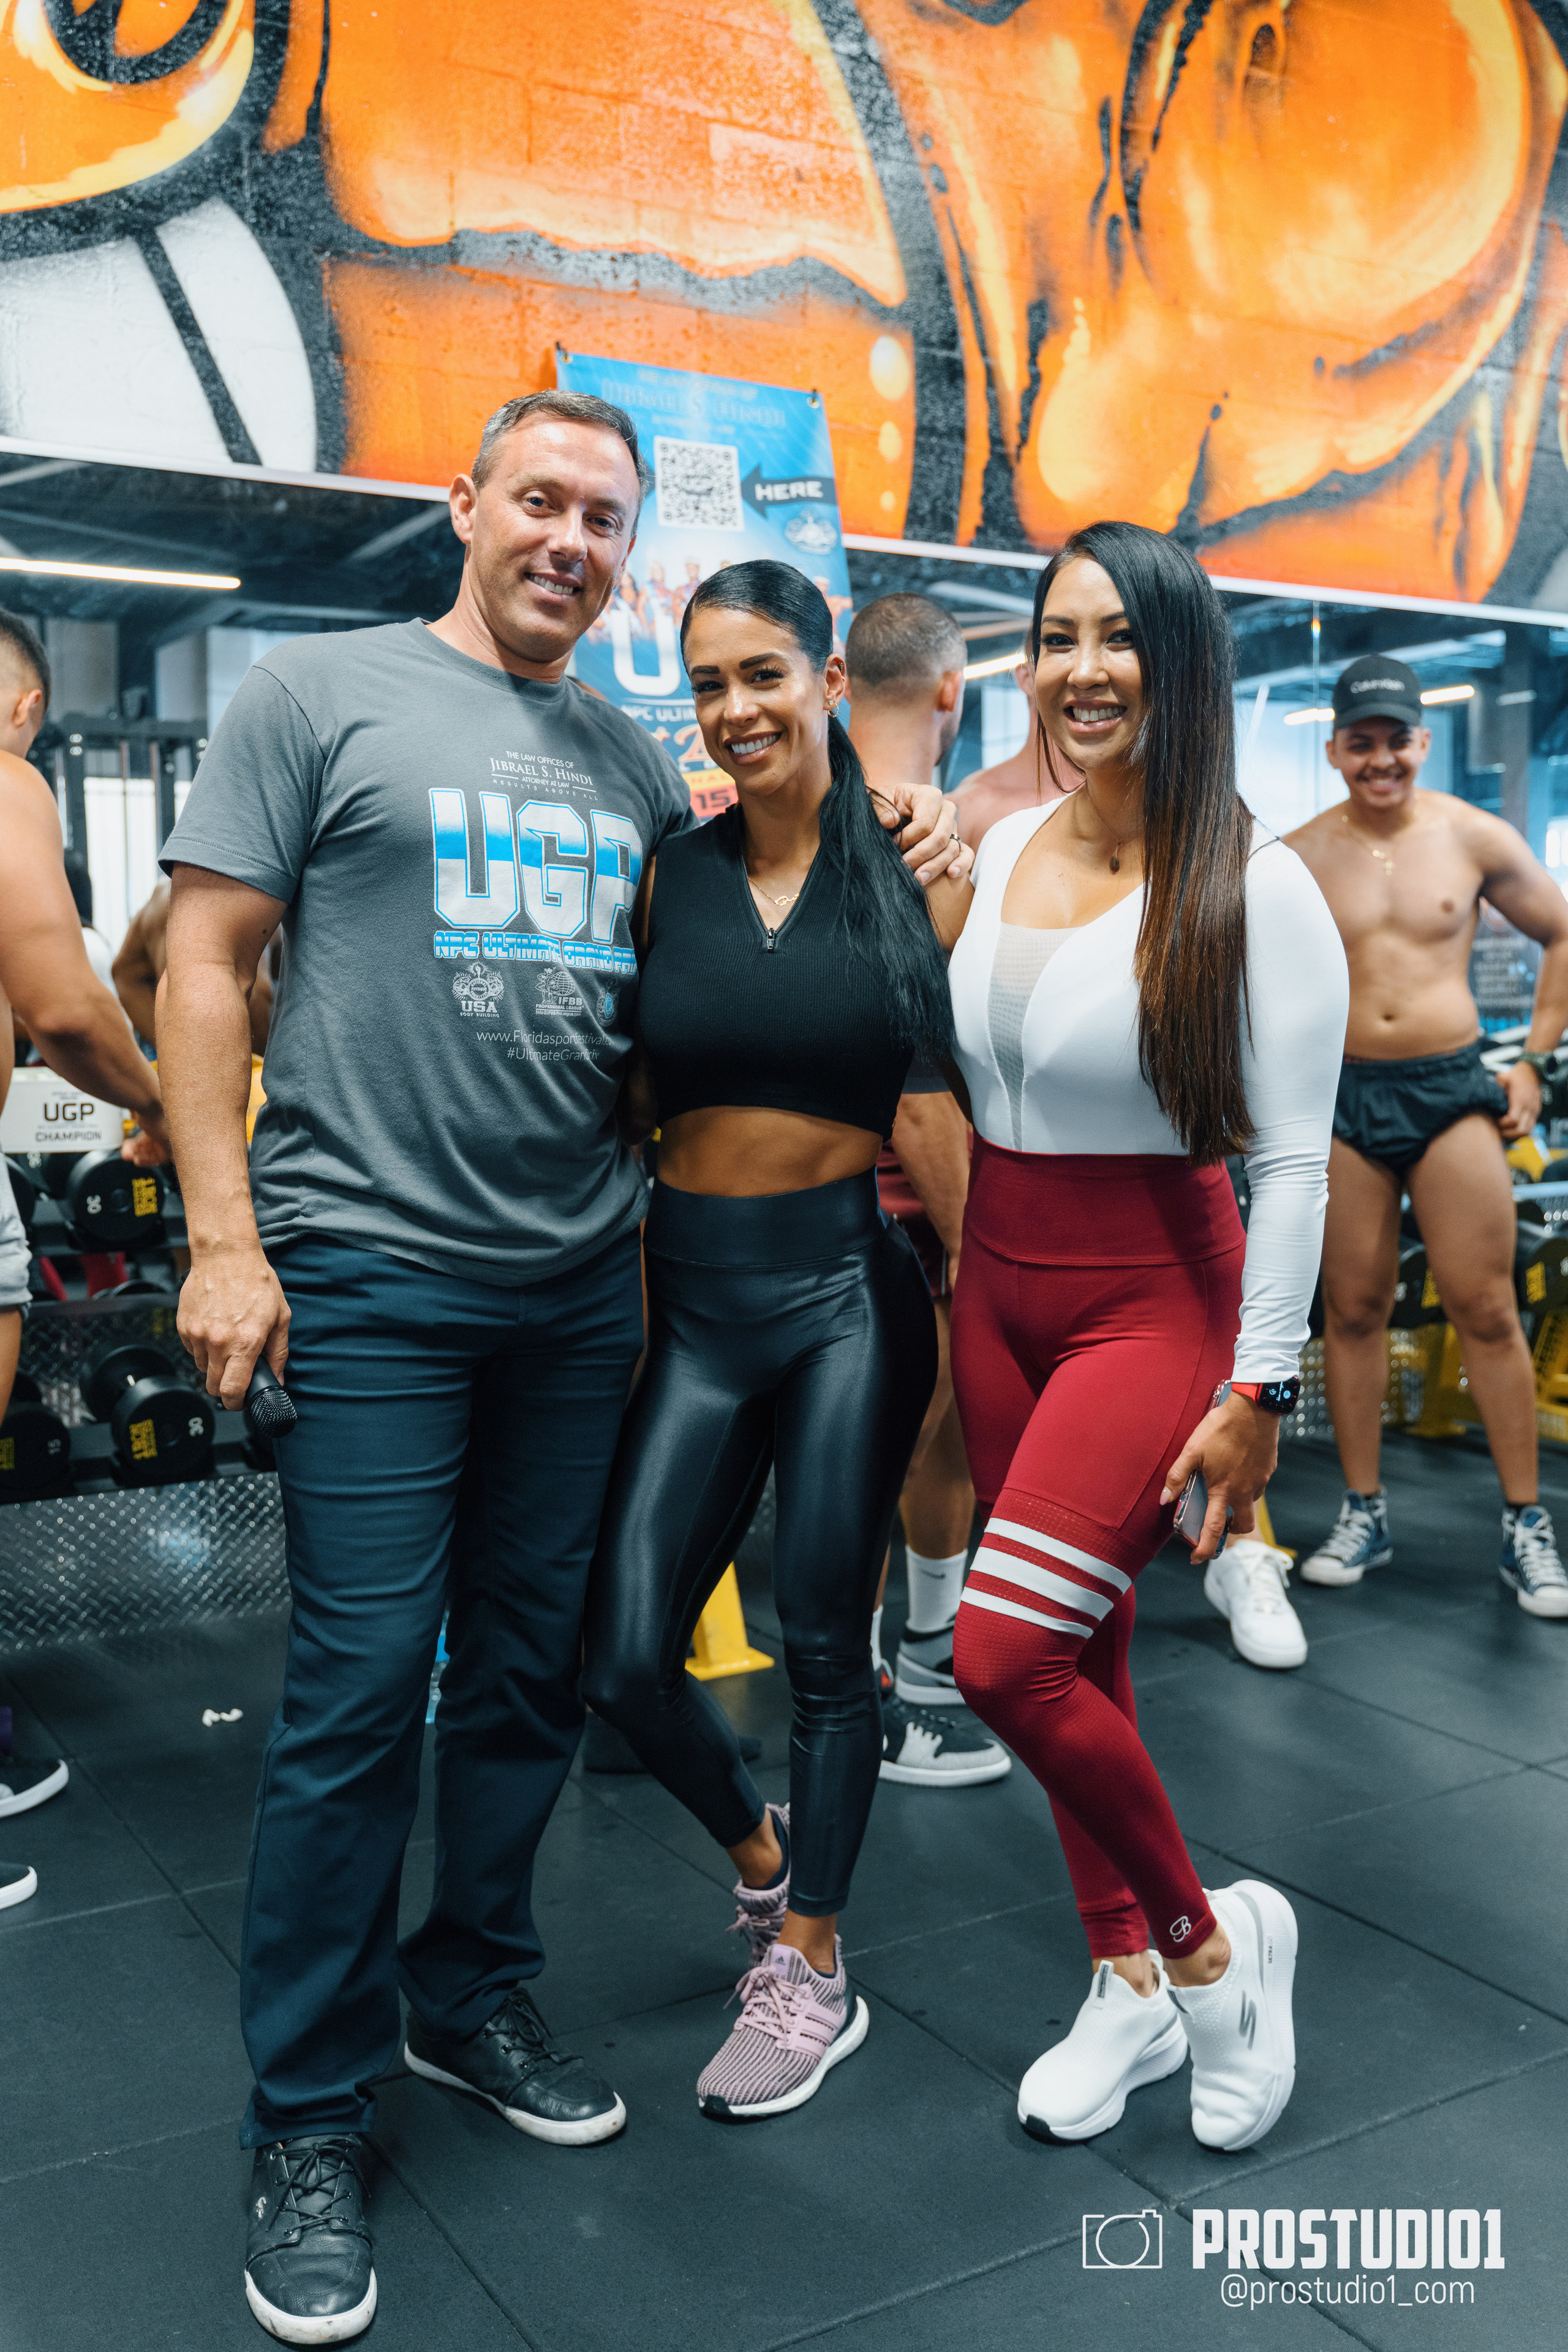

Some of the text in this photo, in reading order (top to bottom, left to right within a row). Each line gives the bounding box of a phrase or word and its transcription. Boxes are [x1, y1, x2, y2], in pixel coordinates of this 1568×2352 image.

[754, 480, 824, 501] HERE
[506, 751, 519, 760] THE
[537, 756, 564, 767] OFFICES
[490, 758, 594, 785] JIBRAEL S. HINDI
[493, 779, 537, 791] RESULTS
[545, 788, 576, 796] ABOVE
[522, 777, 549, 785] ATTORNEY
[695, 789, 730, 810] 15
[429, 788, 643, 944] UGP
[434, 931, 479, 959] NPC
[562, 940, 612, 971] GRAND
[461, 1000, 497, 1013] USA
[558, 997, 582, 1006] IFBB
[44, 1103, 94, 1121] UGP
[35, 1131, 102, 1142] CHAMPION
